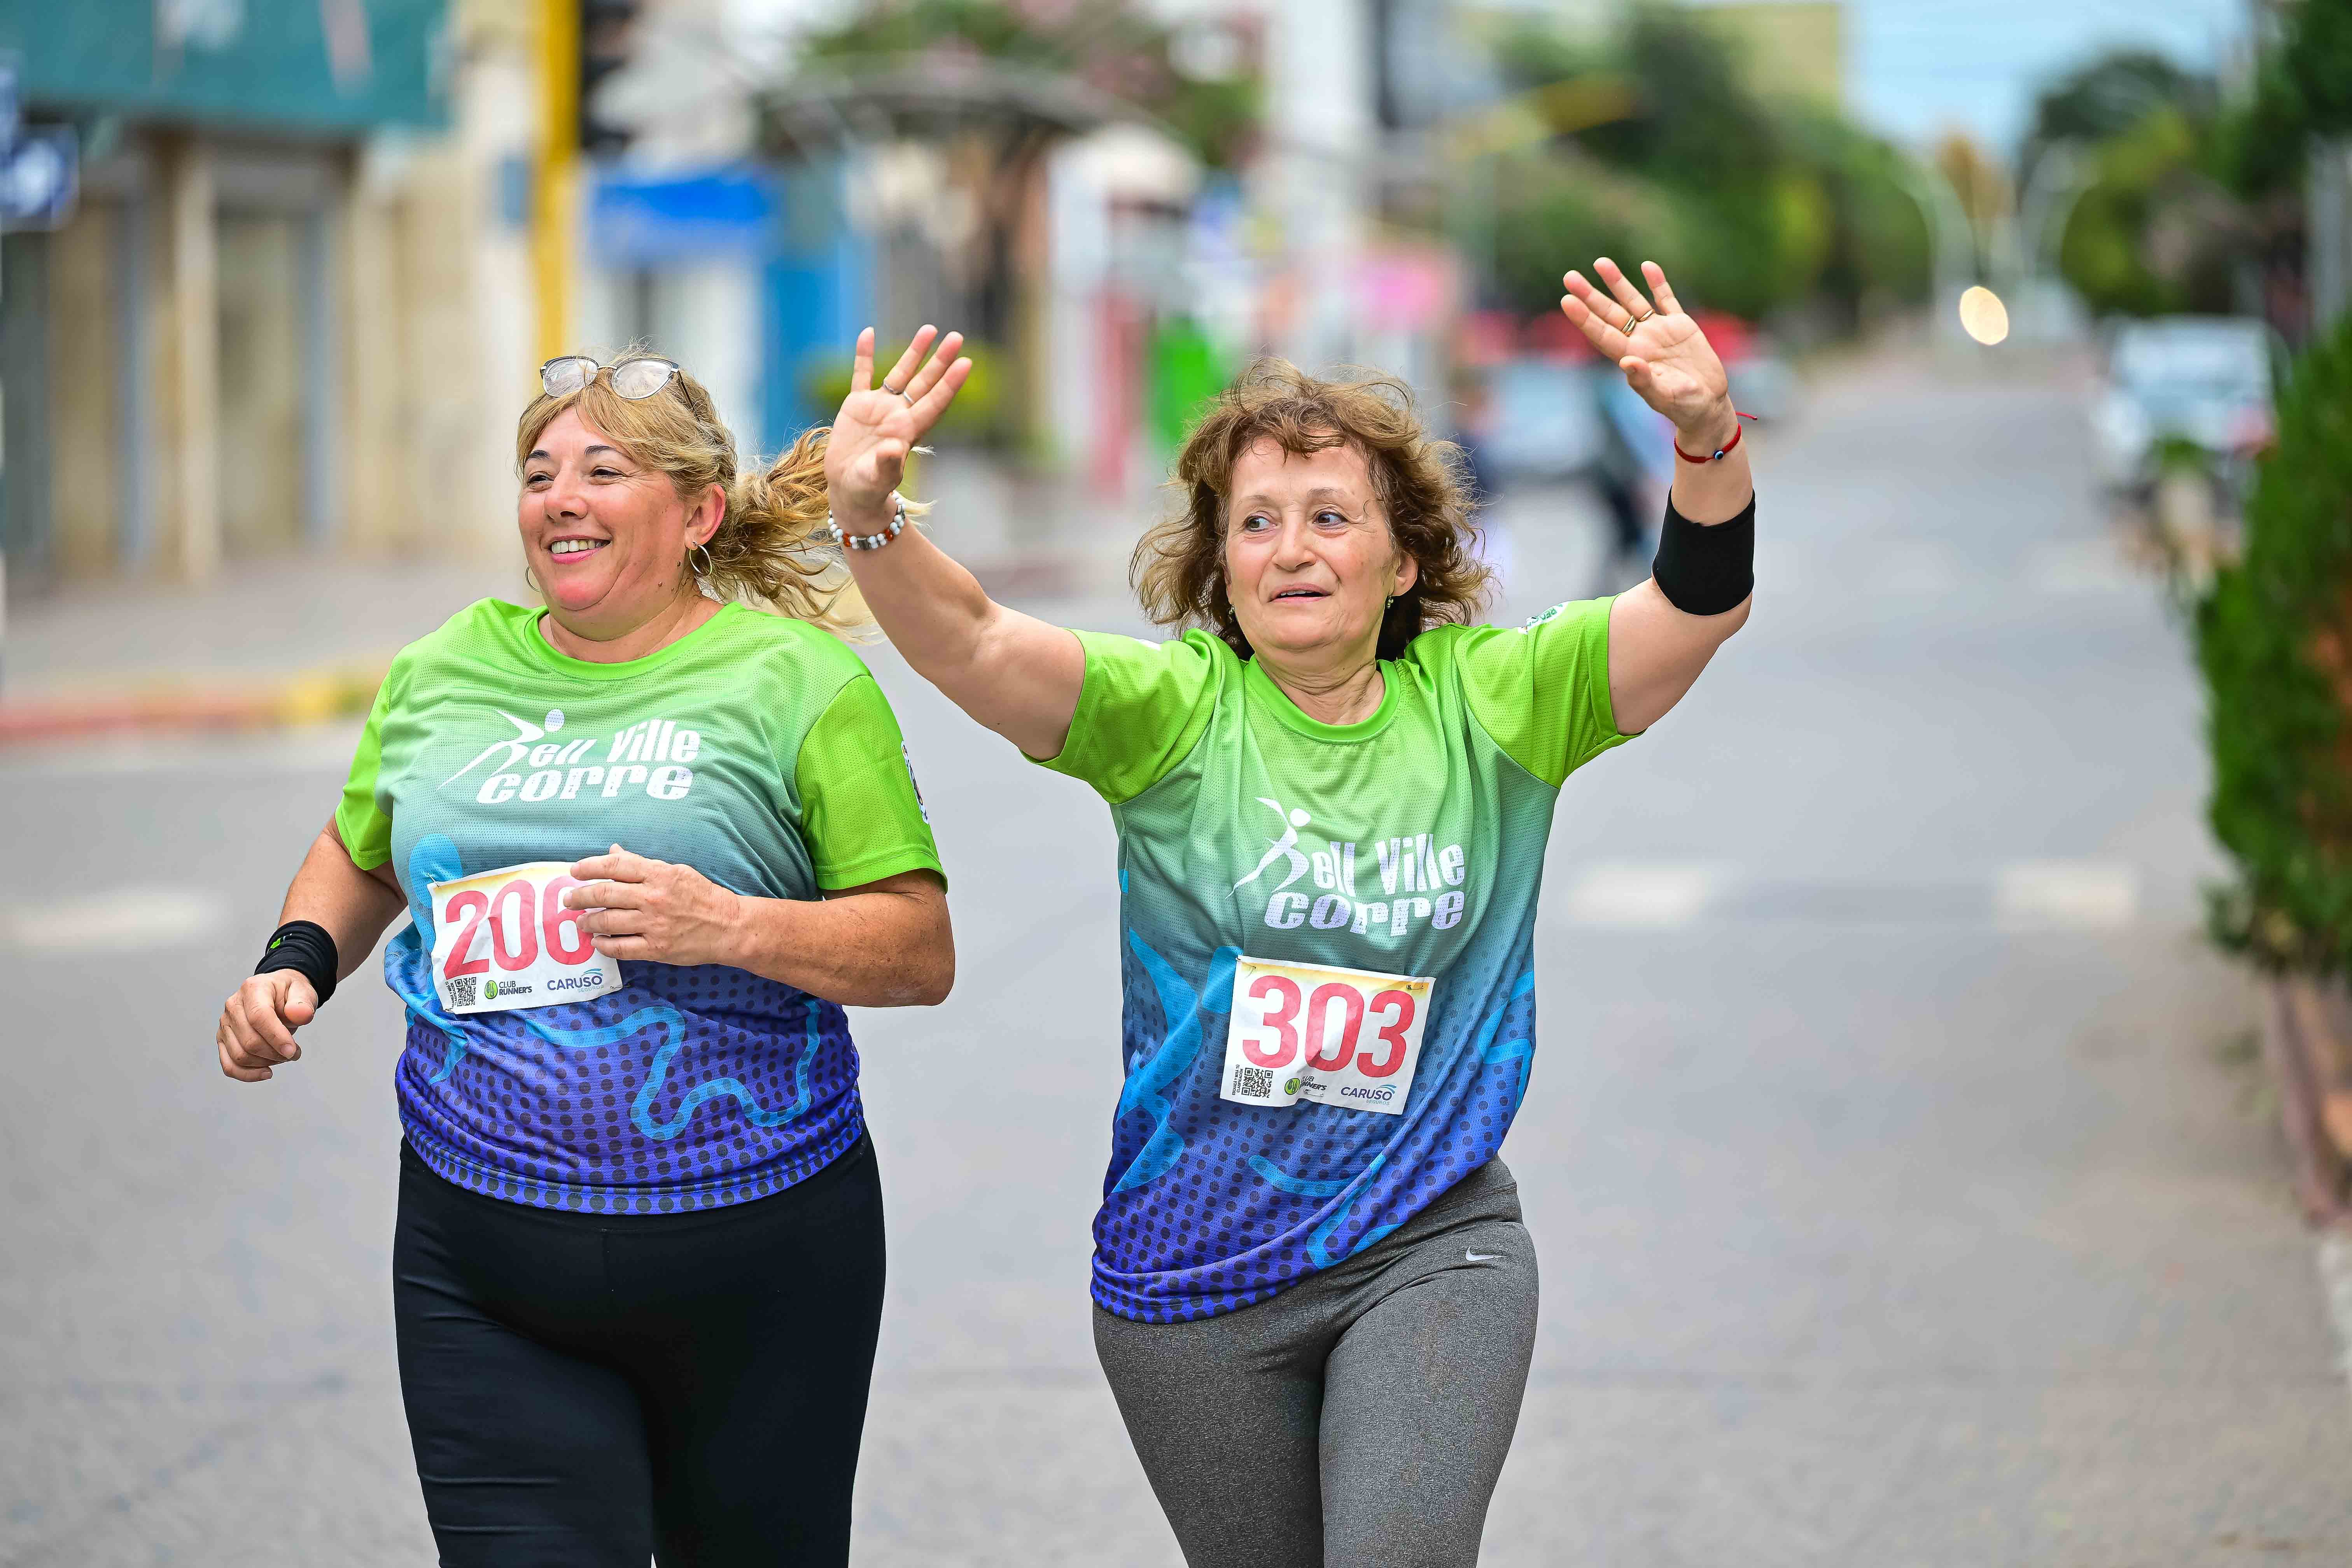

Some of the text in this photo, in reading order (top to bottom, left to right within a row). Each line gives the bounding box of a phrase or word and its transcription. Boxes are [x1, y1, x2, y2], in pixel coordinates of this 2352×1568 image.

[606, 718, 701, 763] Ville
[475, 764, 695, 805] corre
[1374, 833, 1465, 896] Ville
[443, 875, 596, 980] 206
[1264, 890, 1465, 937] corre
[499, 986, 532, 996] RUNNER'S
[547, 975, 602, 990] CARUSO
[578, 984, 604, 992] SEGUROS
[1242, 975, 1416, 1078] 303
[1340, 1087, 1392, 1101] CARUSO
